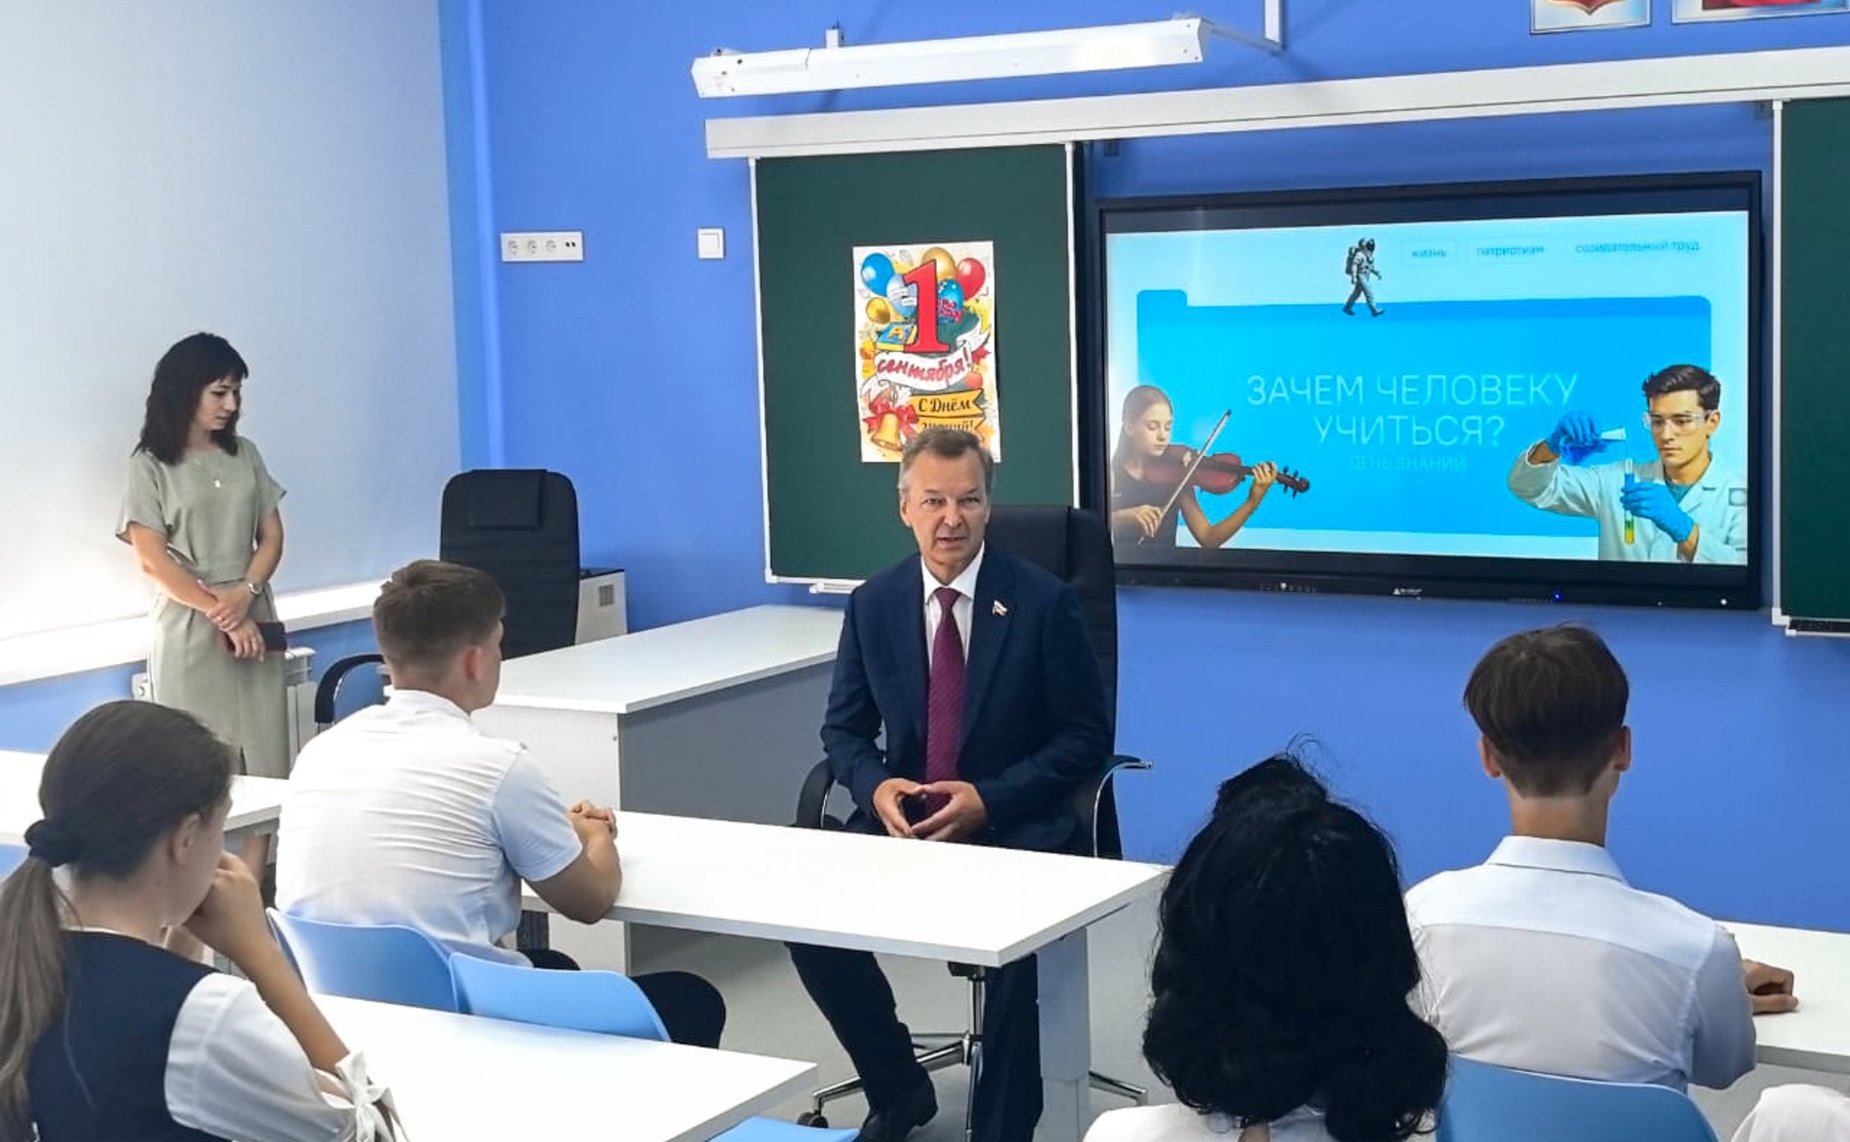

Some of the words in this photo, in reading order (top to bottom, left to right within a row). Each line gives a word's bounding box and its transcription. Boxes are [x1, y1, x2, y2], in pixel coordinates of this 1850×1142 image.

[902, 259, 951, 354] 1
[876, 346, 973, 387] сентября!
[918, 398, 928, 412] С
[930, 398, 971, 412] Днём
[1247, 375, 1364, 406] ЗАЧЕМ
[1376, 374, 1579, 406] ЧЕЛОВЕКУ
[1313, 415, 1506, 447] УЧИТЬСЯ?
[1350, 455, 1392, 471] ДЕНЬ
[1397, 453, 1467, 471] ЗНАНИЙ
